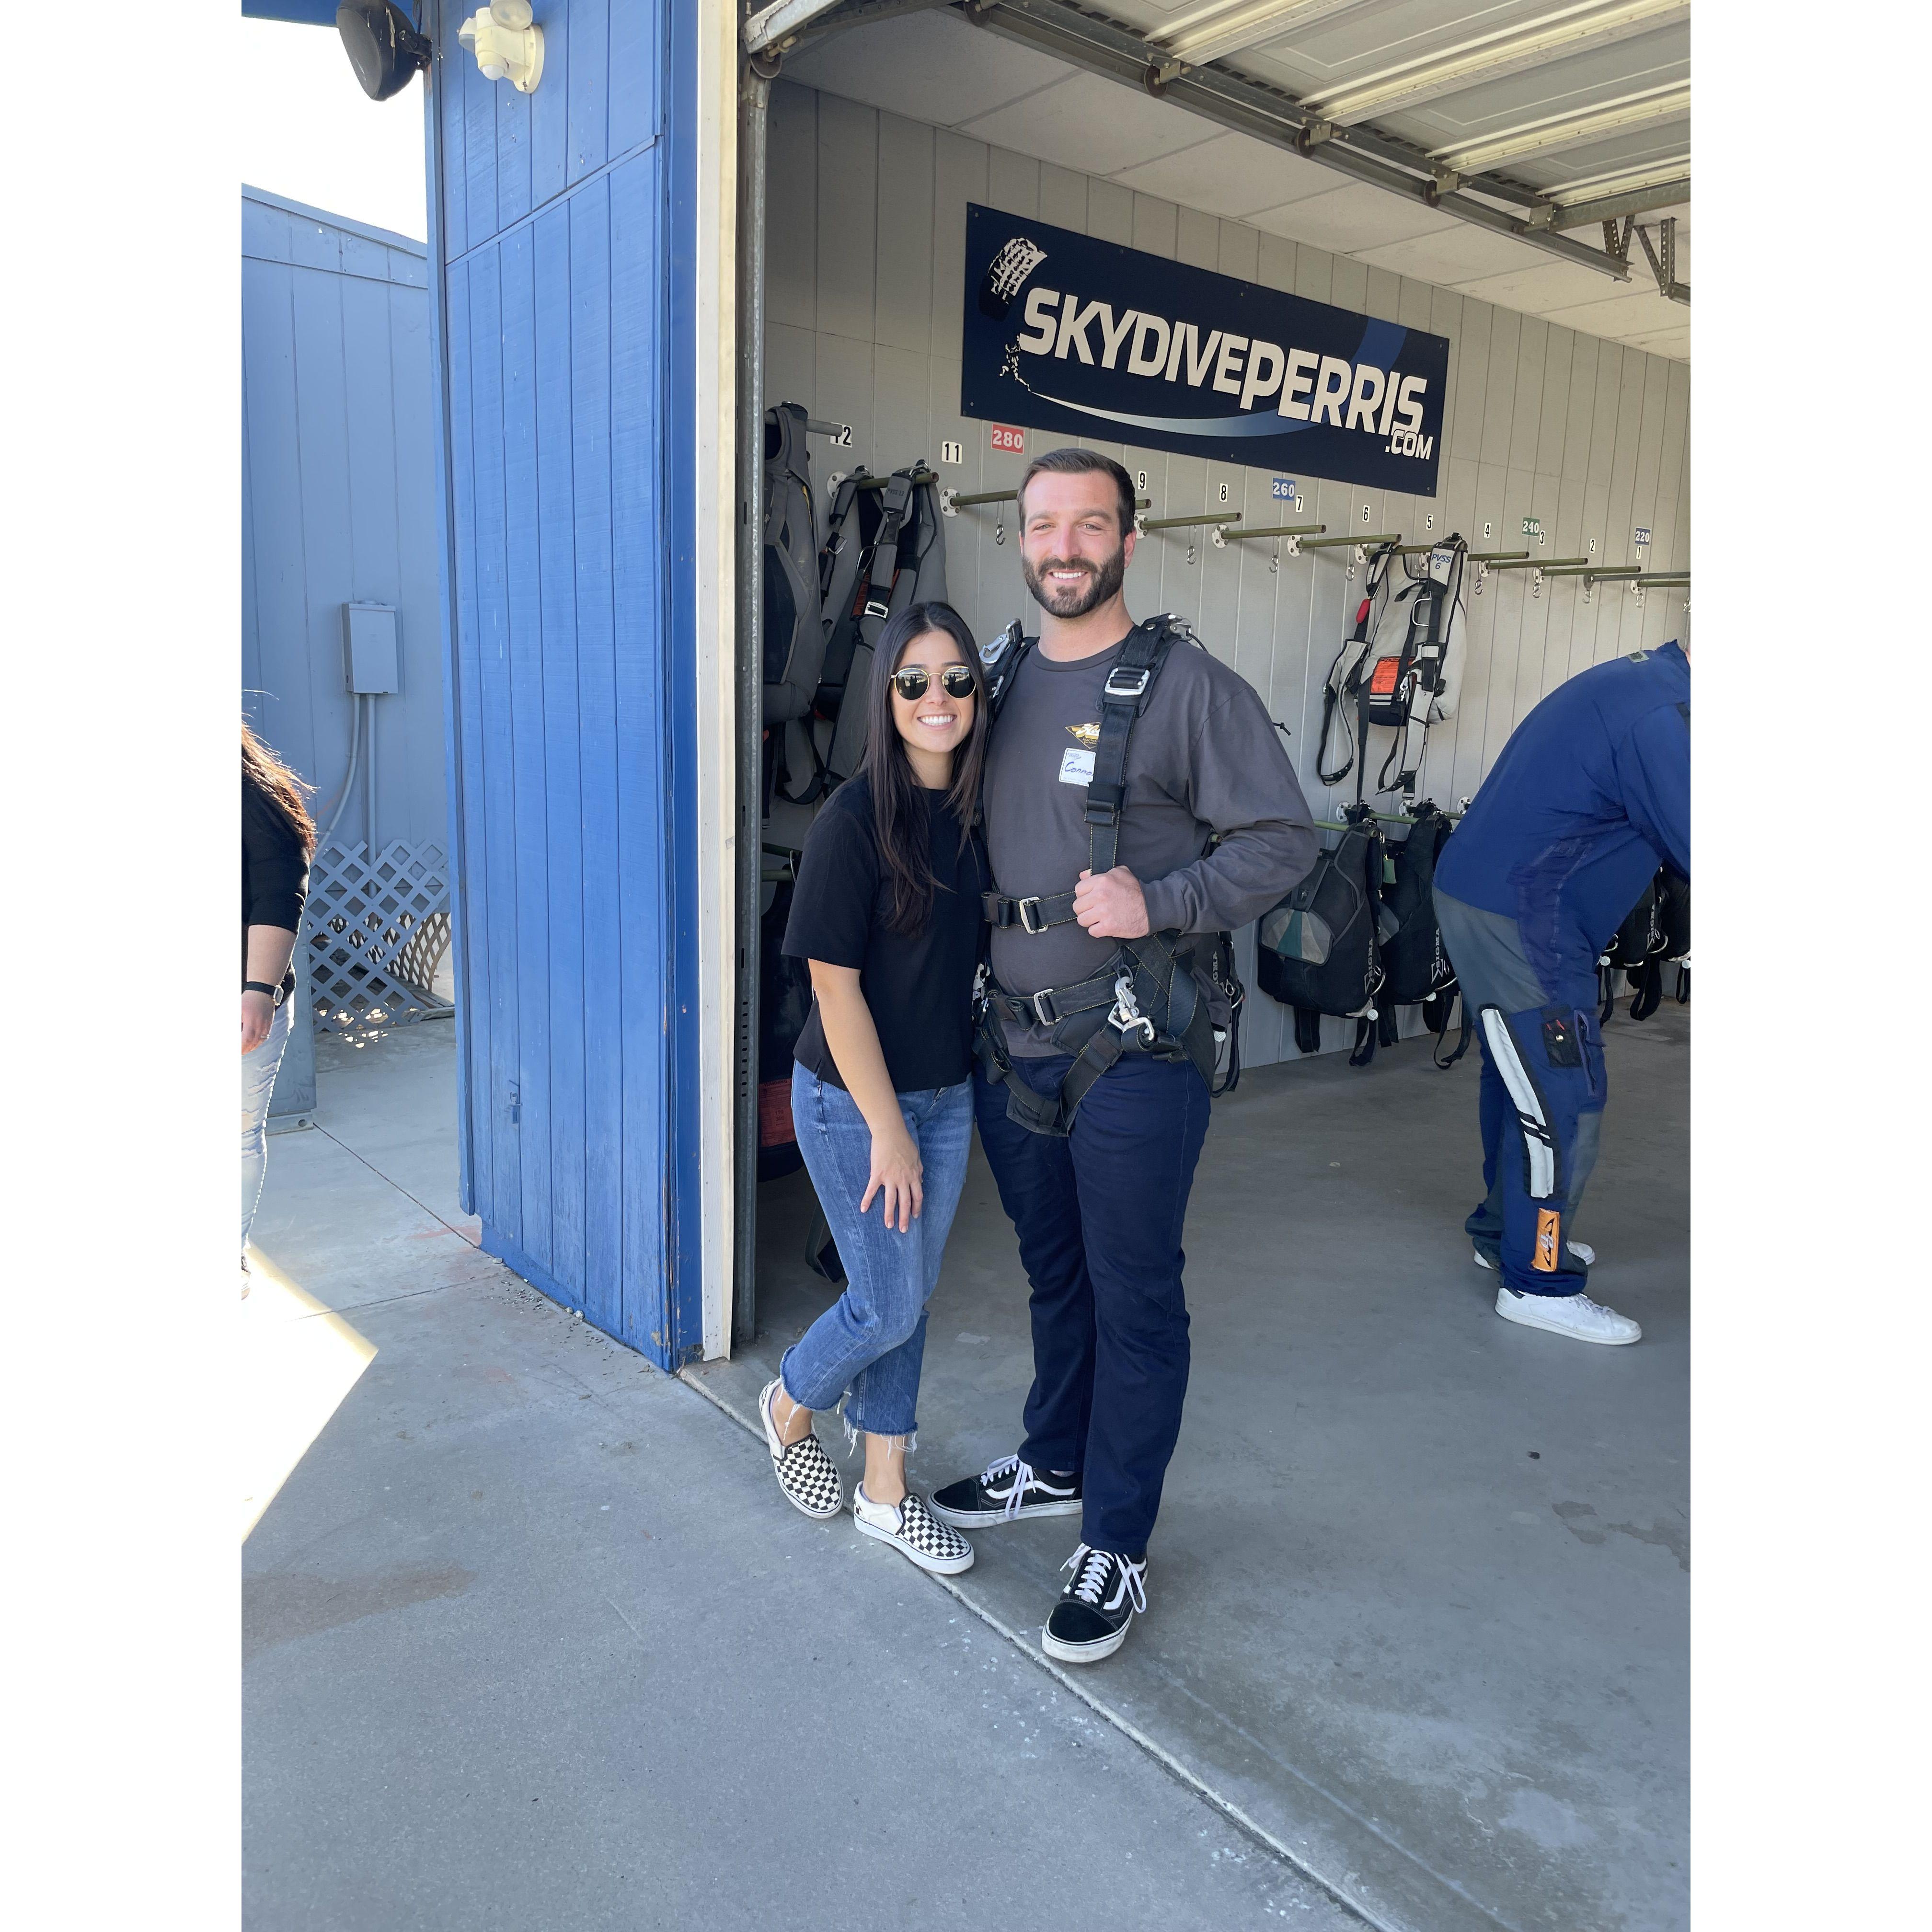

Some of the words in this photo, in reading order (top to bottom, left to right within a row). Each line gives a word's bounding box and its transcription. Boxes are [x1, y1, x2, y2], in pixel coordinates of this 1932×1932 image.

[1019, 288, 1427, 439] SKYDIVEPERRIS
[993, 429, 1023, 448] 280
[1385, 429, 1434, 460] .COM
[945, 443, 959, 462] 11
[1139, 472, 1145, 489] 9
[1221, 485, 1227, 501] 8
[1273, 482, 1295, 497] 260
[1297, 496, 1302, 511] 7
[1364, 506, 1368, 521] 6
[1427, 515, 1432, 529] 5
[1523, 520, 1539, 533] 240
[1485, 524, 1490, 537] 4
[1540, 531, 1544, 544] 3
[1635, 530, 1650, 543] 220
[1590, 540, 1595, 552] 2
[1638, 546, 1641, 558] 1
[1432, 554, 1451, 563] PVSS
[1065, 761, 1094, 776] Conno
